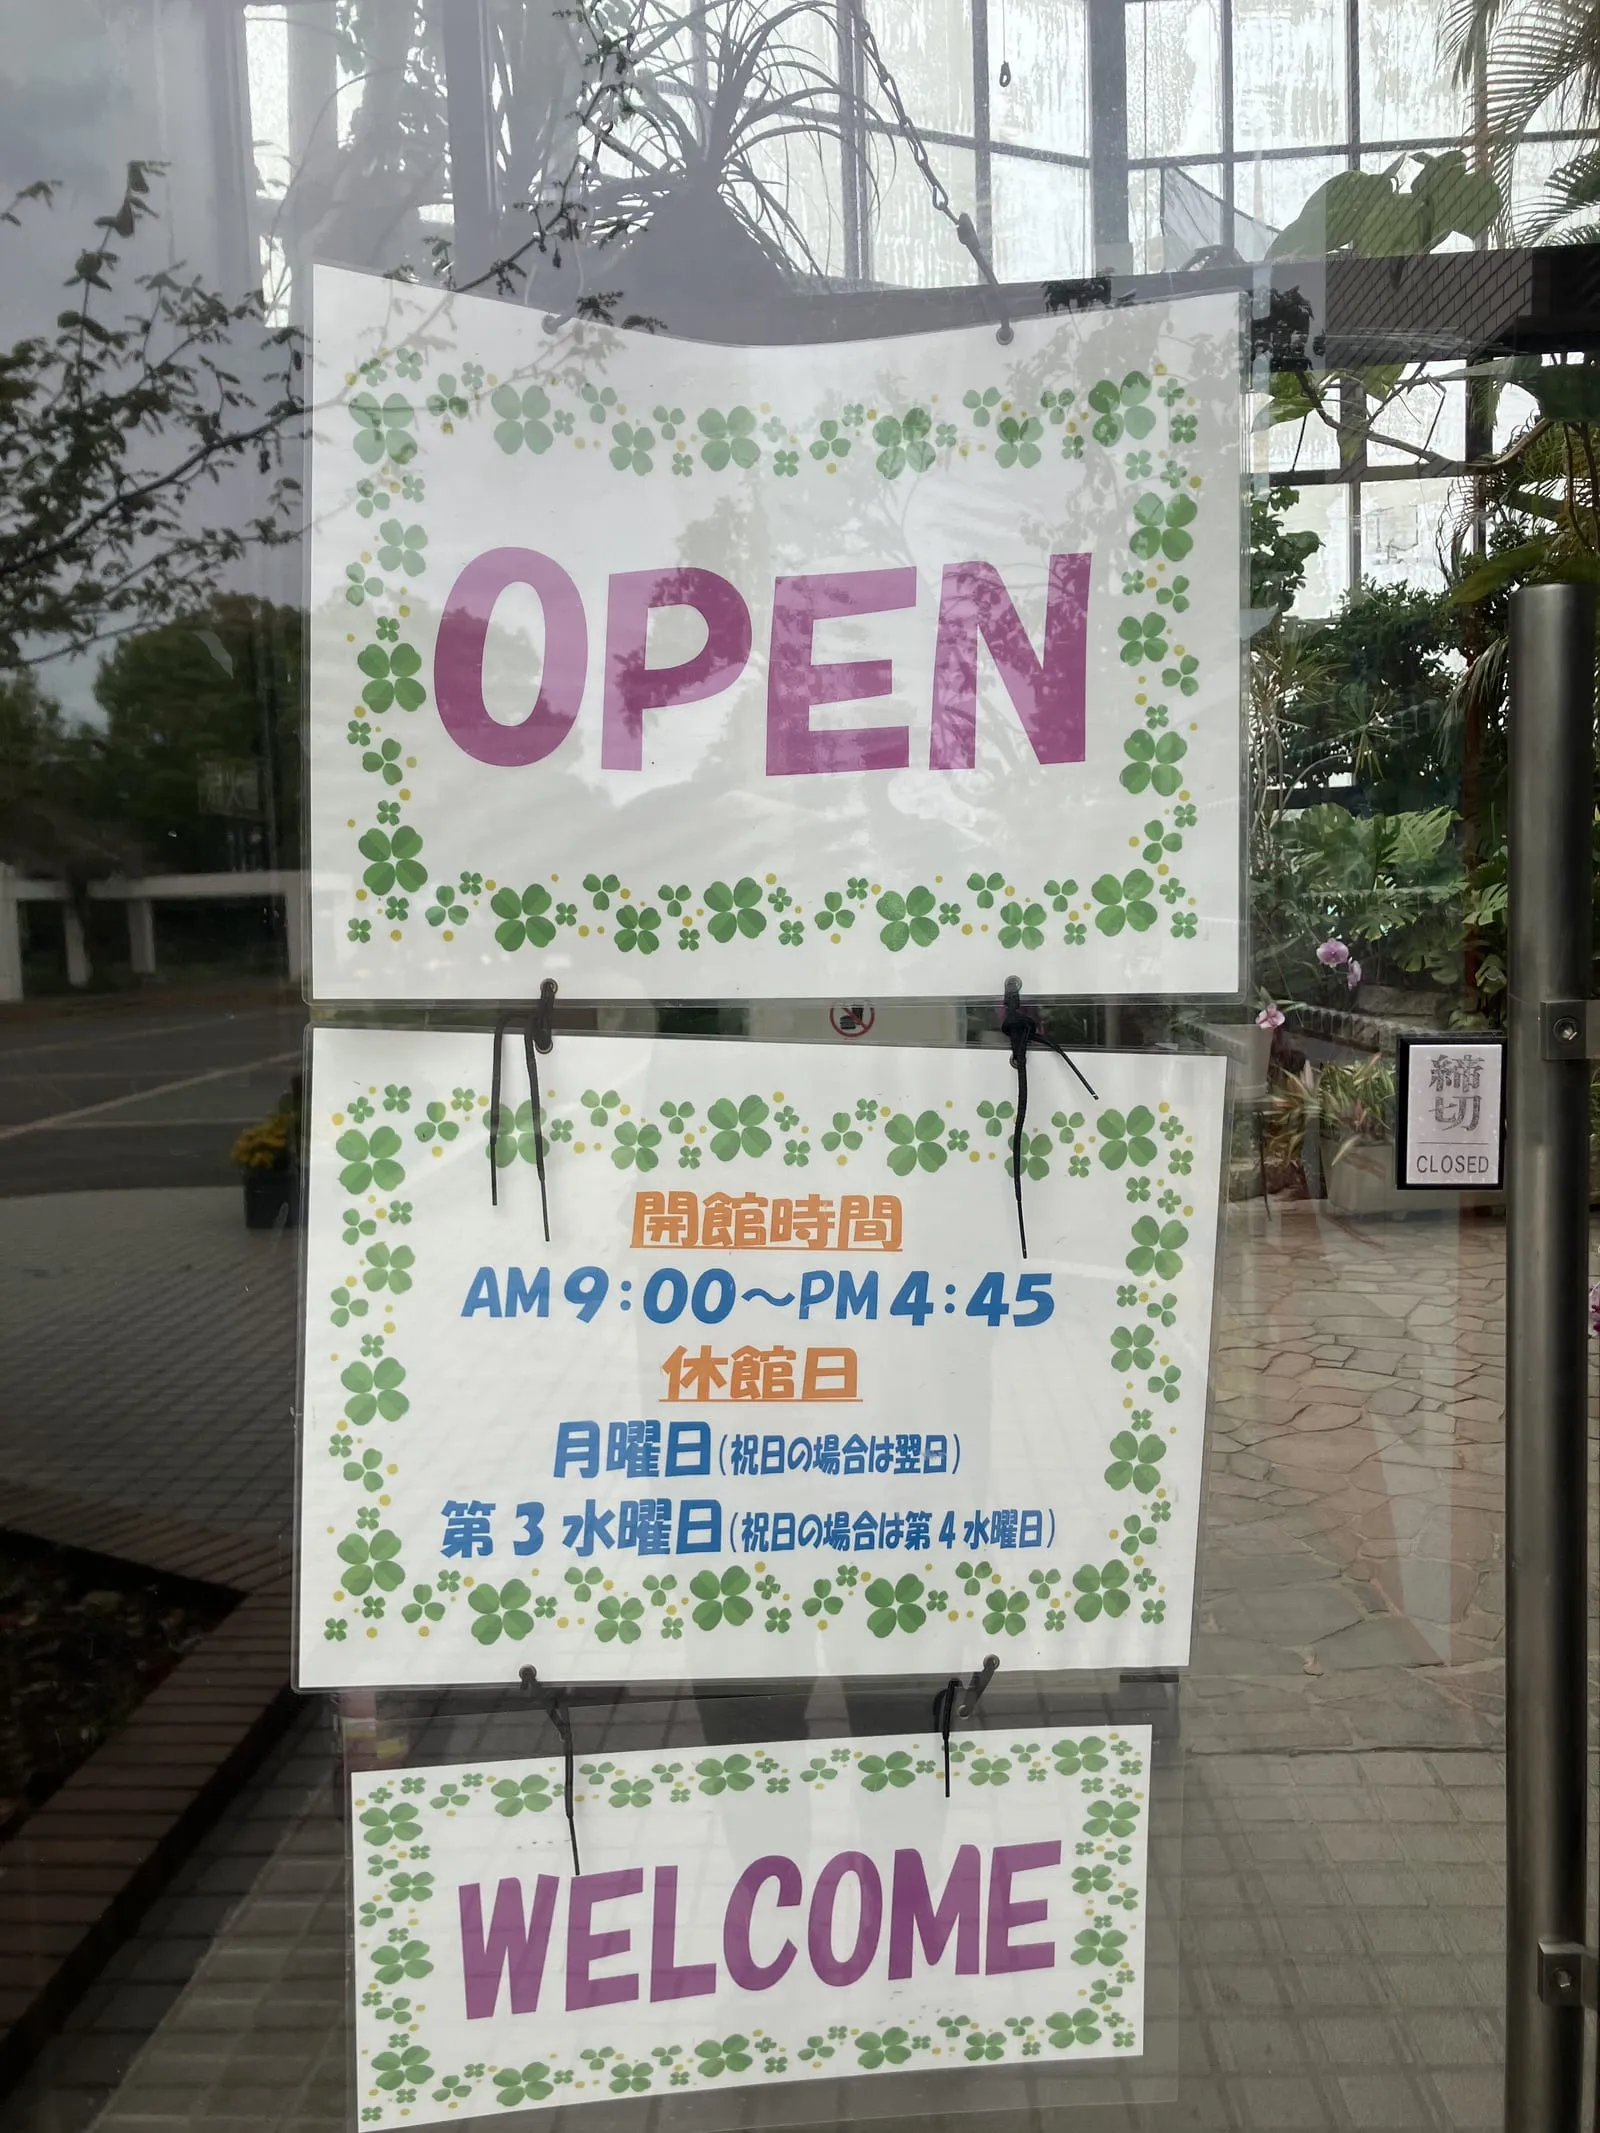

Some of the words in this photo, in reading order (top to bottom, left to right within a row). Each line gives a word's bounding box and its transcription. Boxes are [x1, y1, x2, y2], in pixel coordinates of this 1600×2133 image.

[435, 547, 1092, 777] OPEN
[1428, 1054, 1485, 1132] 締切
[1416, 1154, 1489, 1174] CLOSED
[631, 1191, 903, 1250] 開館時間
[661, 1344, 860, 1400] 休館日
[459, 1840, 1062, 2020] WELCOME
